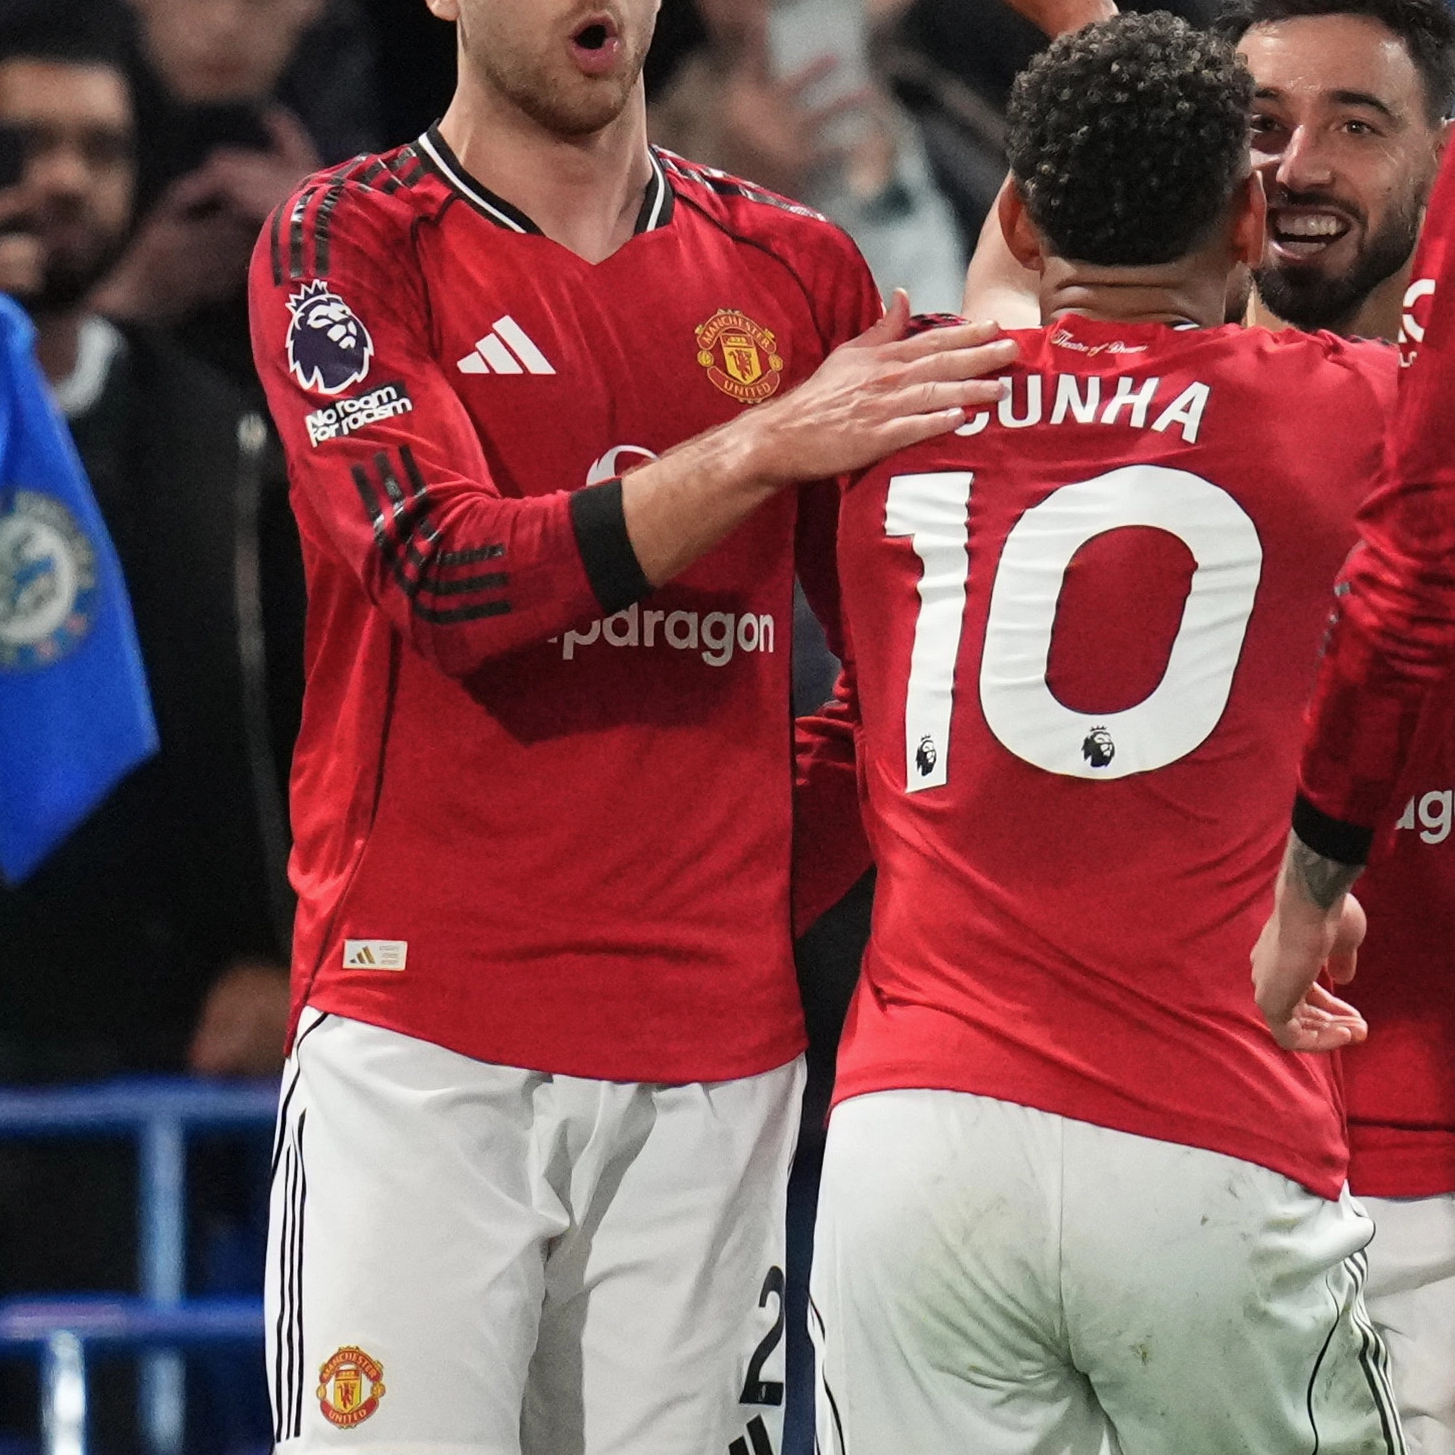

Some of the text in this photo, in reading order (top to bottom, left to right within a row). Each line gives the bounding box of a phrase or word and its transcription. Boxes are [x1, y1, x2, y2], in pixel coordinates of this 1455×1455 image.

[305, 386, 397, 429] No room
[724, 379, 771, 397] UNITED
[308, 398, 413, 448] for racism
[547, 601, 775, 667] pdragon
[884, 464, 1263, 792] 10
[739, 1265, 785, 1406] 2
